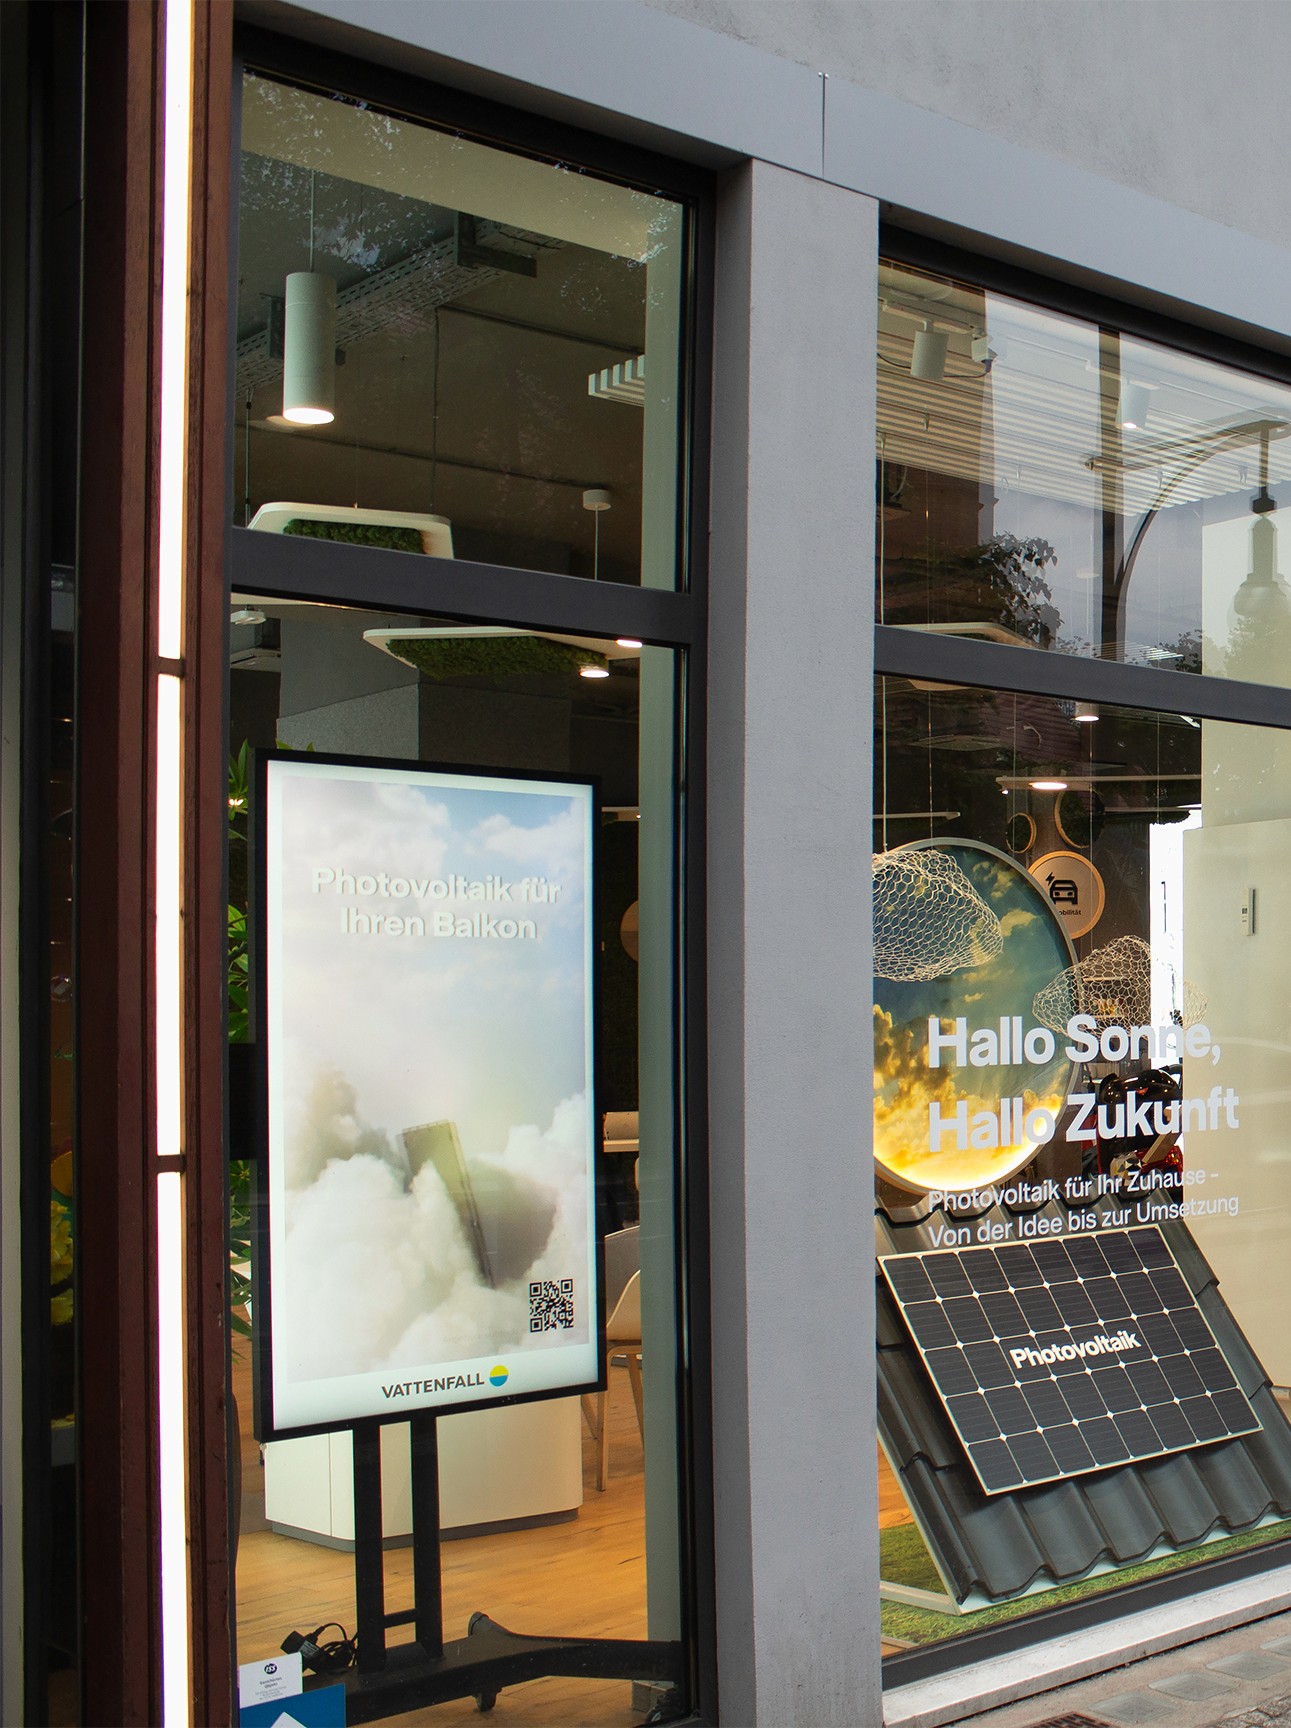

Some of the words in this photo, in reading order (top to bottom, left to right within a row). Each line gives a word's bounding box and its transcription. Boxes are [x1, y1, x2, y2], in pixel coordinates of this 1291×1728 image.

[312, 866, 512, 902] Photovoltaik
[520, 876, 562, 904] für
[341, 907, 425, 936] Ihren
[433, 911, 538, 939] Balkon
[928, 1016, 1055, 1069] Hallo
[1066, 1013, 1221, 1066] Sonne,
[929, 1097, 1056, 1152] Hallo
[1066, 1085, 1240, 1143] Zukunft
[928, 1180, 1060, 1213] Photovoltaik
[1065, 1177, 1093, 1199] für
[1097, 1172, 1124, 1194] Ihr
[1127, 1168, 1206, 1192] Zuhause
[928, 1222, 971, 1248] Von
[977, 1219, 1013, 1243] der
[1019, 1214, 1063, 1238] Idee
[1068, 1208, 1096, 1230] bis
[1102, 1208, 1131, 1228] zur
[1136, 1194, 1239, 1222] Umsetzung
[1009, 1330, 1142, 1369] Photovoltaik
[381, 1373, 485, 1399] VATTENFALL
